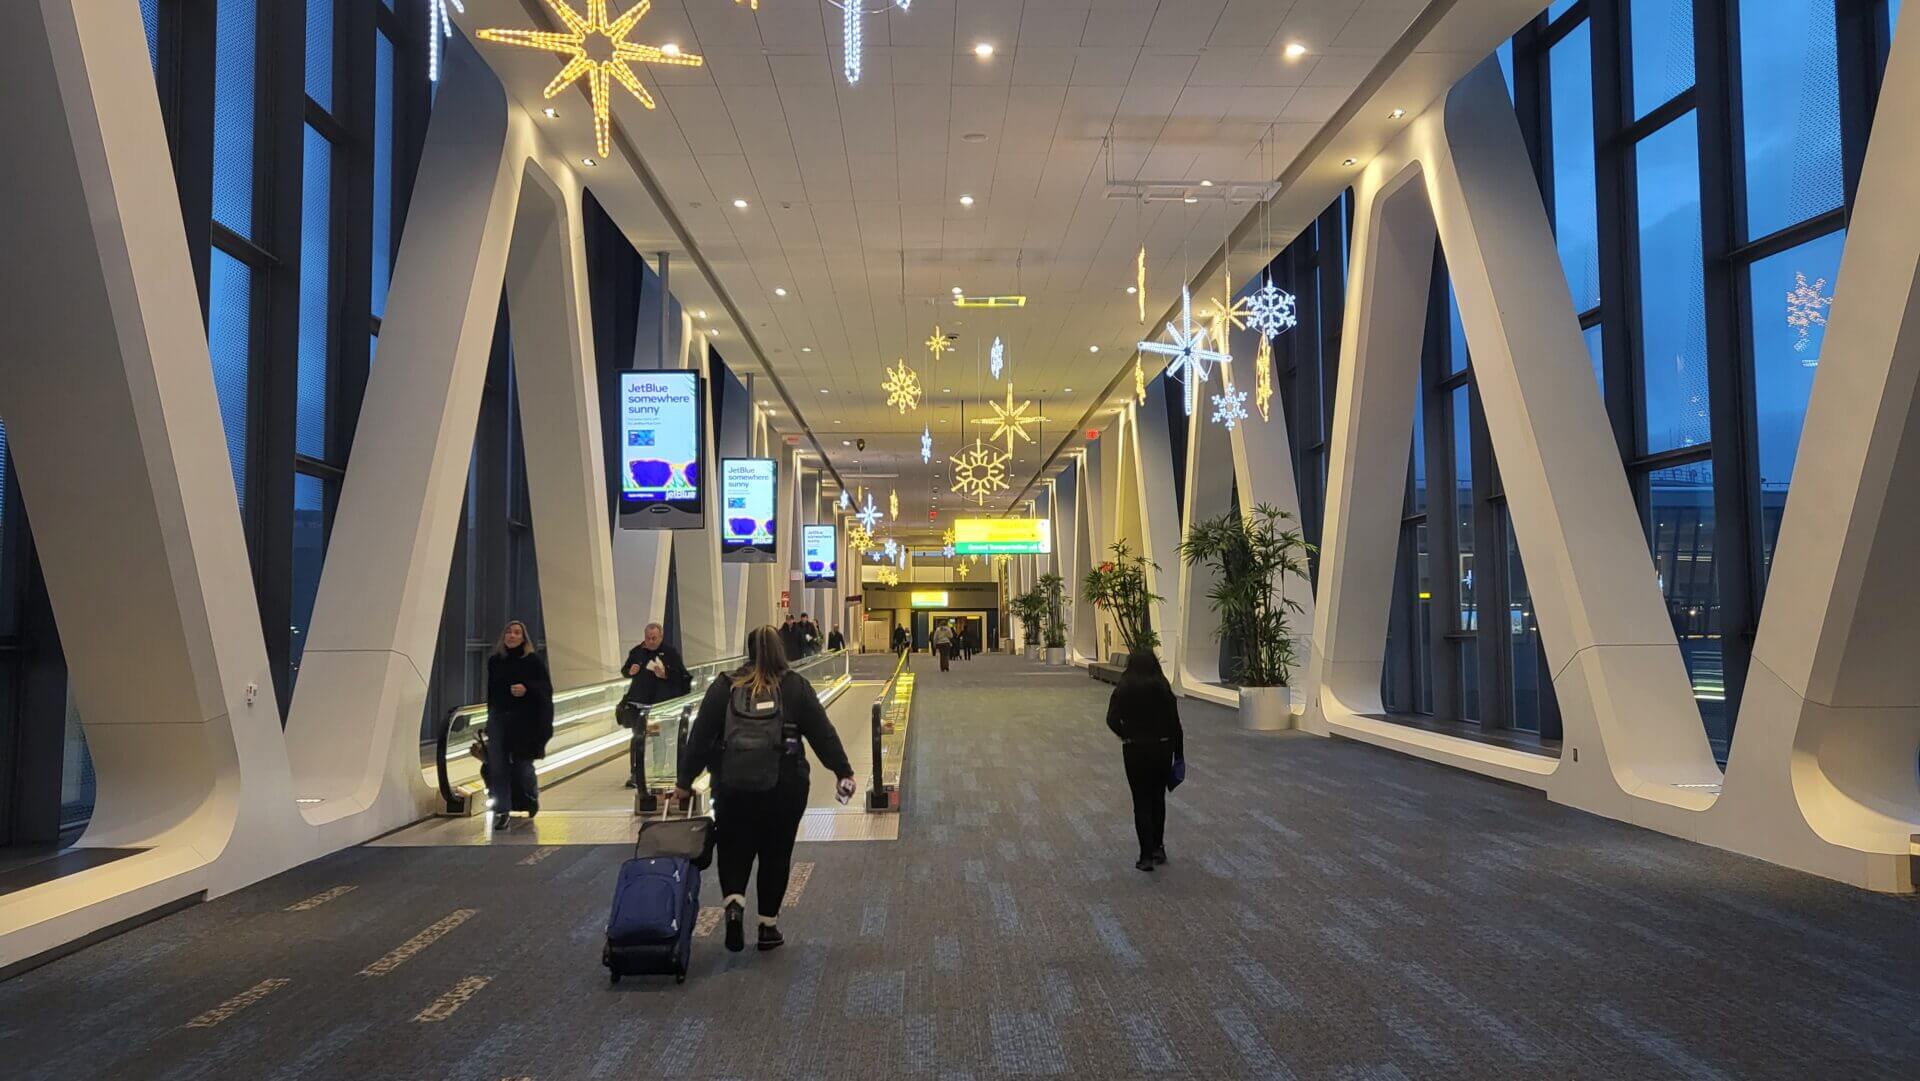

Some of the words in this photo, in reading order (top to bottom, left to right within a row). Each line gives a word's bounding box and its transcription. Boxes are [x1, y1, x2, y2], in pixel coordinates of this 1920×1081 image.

[628, 383, 668, 393] JetBlue
[628, 394, 690, 403] somewhere
[628, 406, 660, 416] sunny
